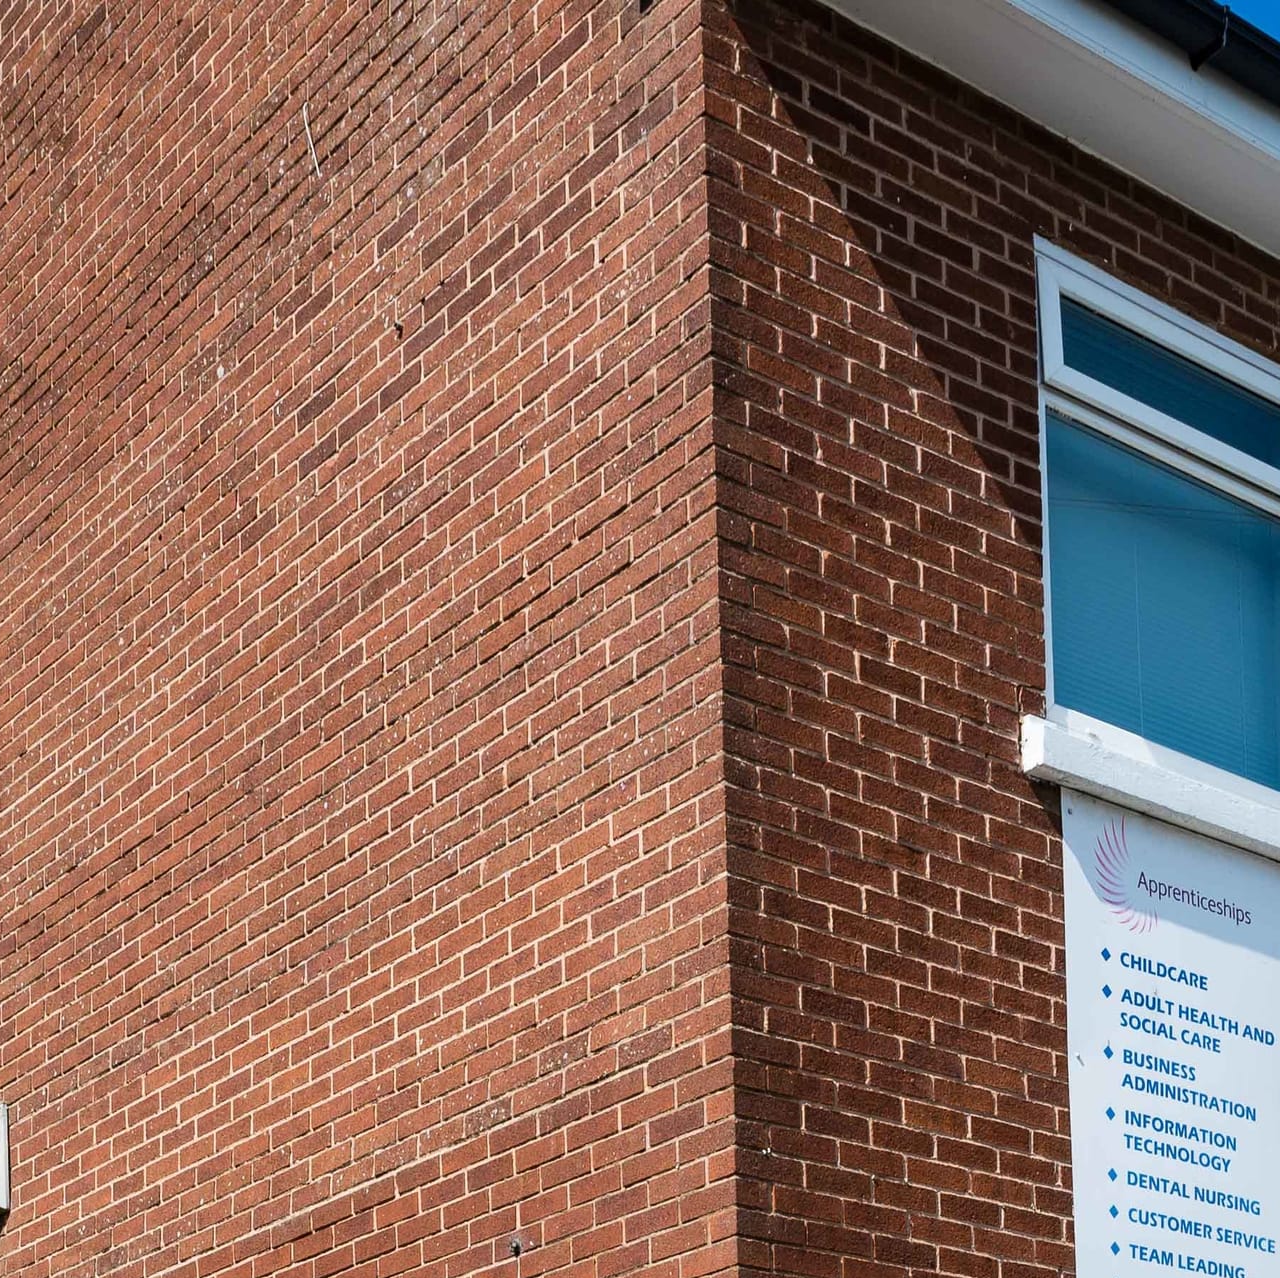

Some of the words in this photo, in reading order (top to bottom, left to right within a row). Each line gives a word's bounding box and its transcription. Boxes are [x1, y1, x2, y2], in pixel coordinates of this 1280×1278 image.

[1137, 872, 1252, 925] Apprenticeships
[1120, 952, 1208, 990] CHILDCARE
[1120, 1012, 1177, 1040] SOCIAL
[1181, 1030, 1221, 1053] CARE
[1121, 989, 1174, 1015] ADULT
[1178, 1004, 1238, 1035] HEALTH
[1242, 1025, 1275, 1046] AND
[1123, 1049, 1196, 1081] BUSINESS
[1122, 1074, 1256, 1122] ADMINISTRATION
[1125, 1110, 1237, 1151] INFORMATION
[1123, 1134, 1231, 1173] TECHNOLOGY
[1127, 1171, 1190, 1198] DENTAL
[1194, 1186, 1261, 1215] NURSING
[1128, 1208, 1212, 1239] CUSTOMER
[1217, 1227, 1275, 1254] SERVICE
[1129, 1244, 1174, 1267] TEAM
